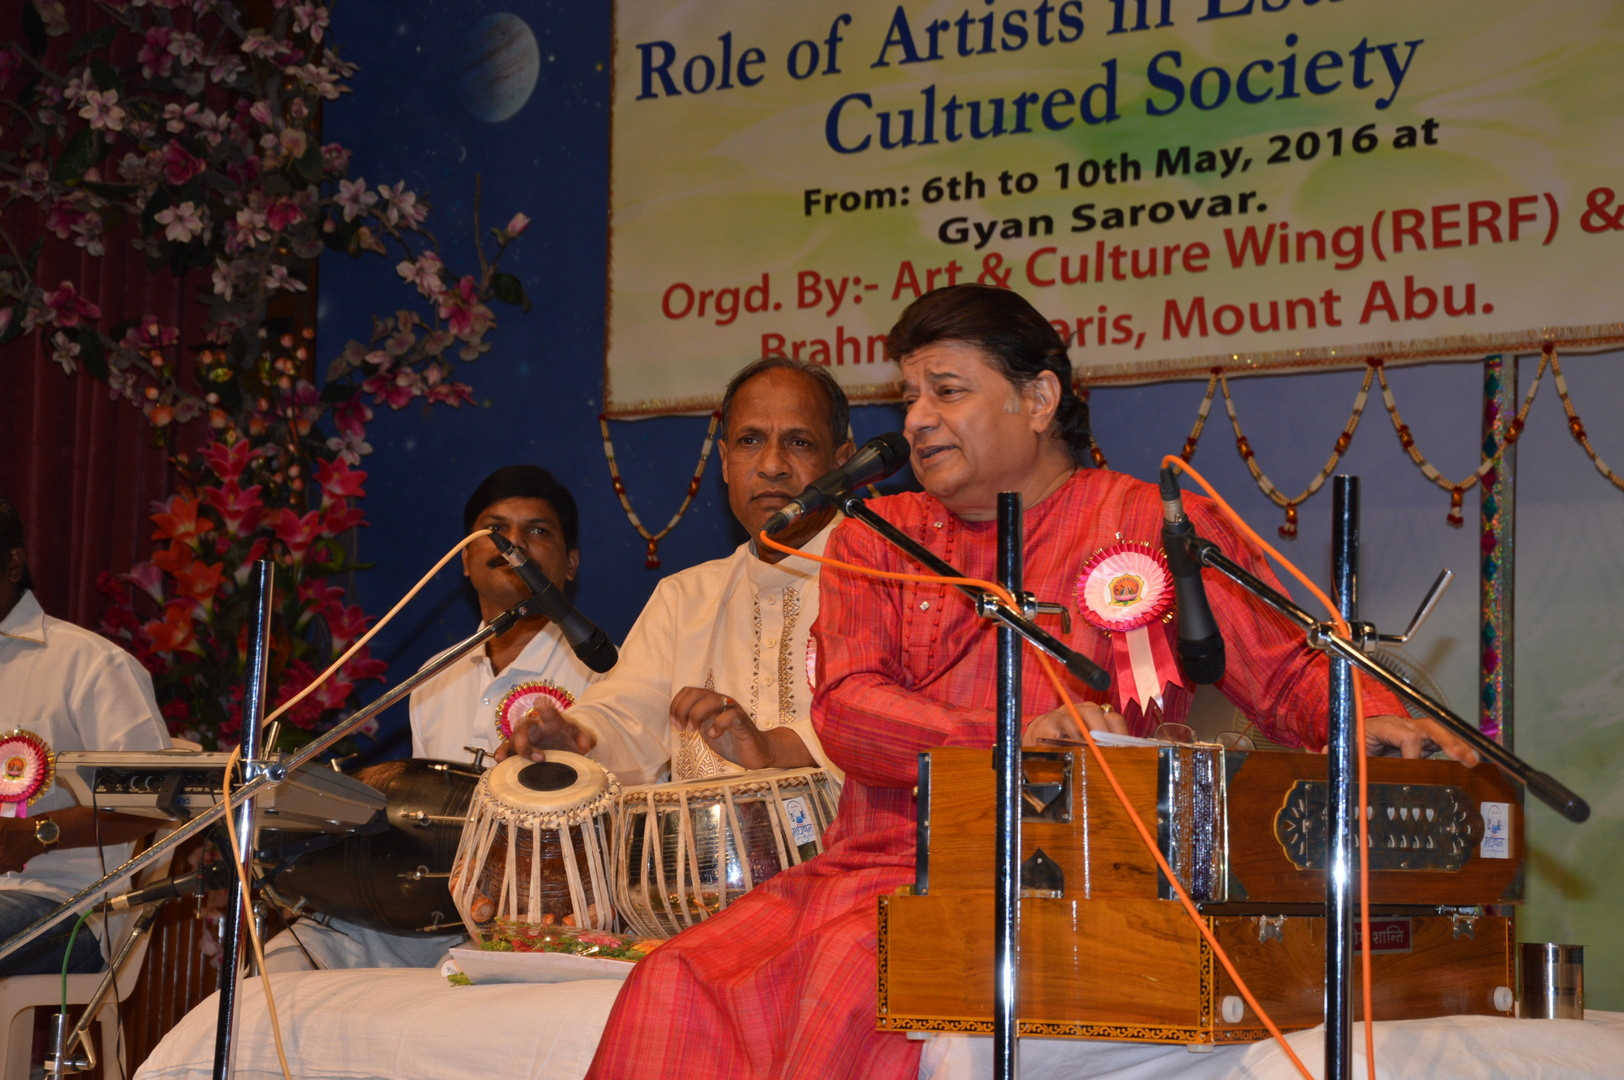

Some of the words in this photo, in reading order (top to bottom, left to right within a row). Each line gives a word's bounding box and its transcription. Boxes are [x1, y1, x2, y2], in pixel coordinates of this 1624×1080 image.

[635, 31, 766, 100] Role
[787, 14, 852, 80] of
[871, 0, 1084, 69] Artists
[825, 59, 1121, 154] Cultured
[1146, 34, 1424, 117] Society
[804, 184, 910, 217] From:
[922, 171, 986, 204] 6th
[998, 167, 1038, 196] to
[1055, 151, 1142, 189] 10th
[1155, 145, 1253, 179] May,
[1267, 123, 1379, 165] 2016
[1392, 118, 1439, 149] at
[661, 273, 783, 327] Orgd.
[797, 270, 879, 318] By:-
[891, 259, 963, 301] Art
[977, 251, 1012, 289] &
[1025, 241, 1211, 288] Culture
[1223, 192, 1559, 271] Wing(RERF)
[1579, 187, 1624, 233] &
[938, 215, 1054, 250] Gyan
[1071, 191, 1268, 233] Sarovar.
[761, 325, 890, 368] Brahm
[1162, 288, 1342, 341] Mount
[1359, 274, 1495, 324] Abu.
